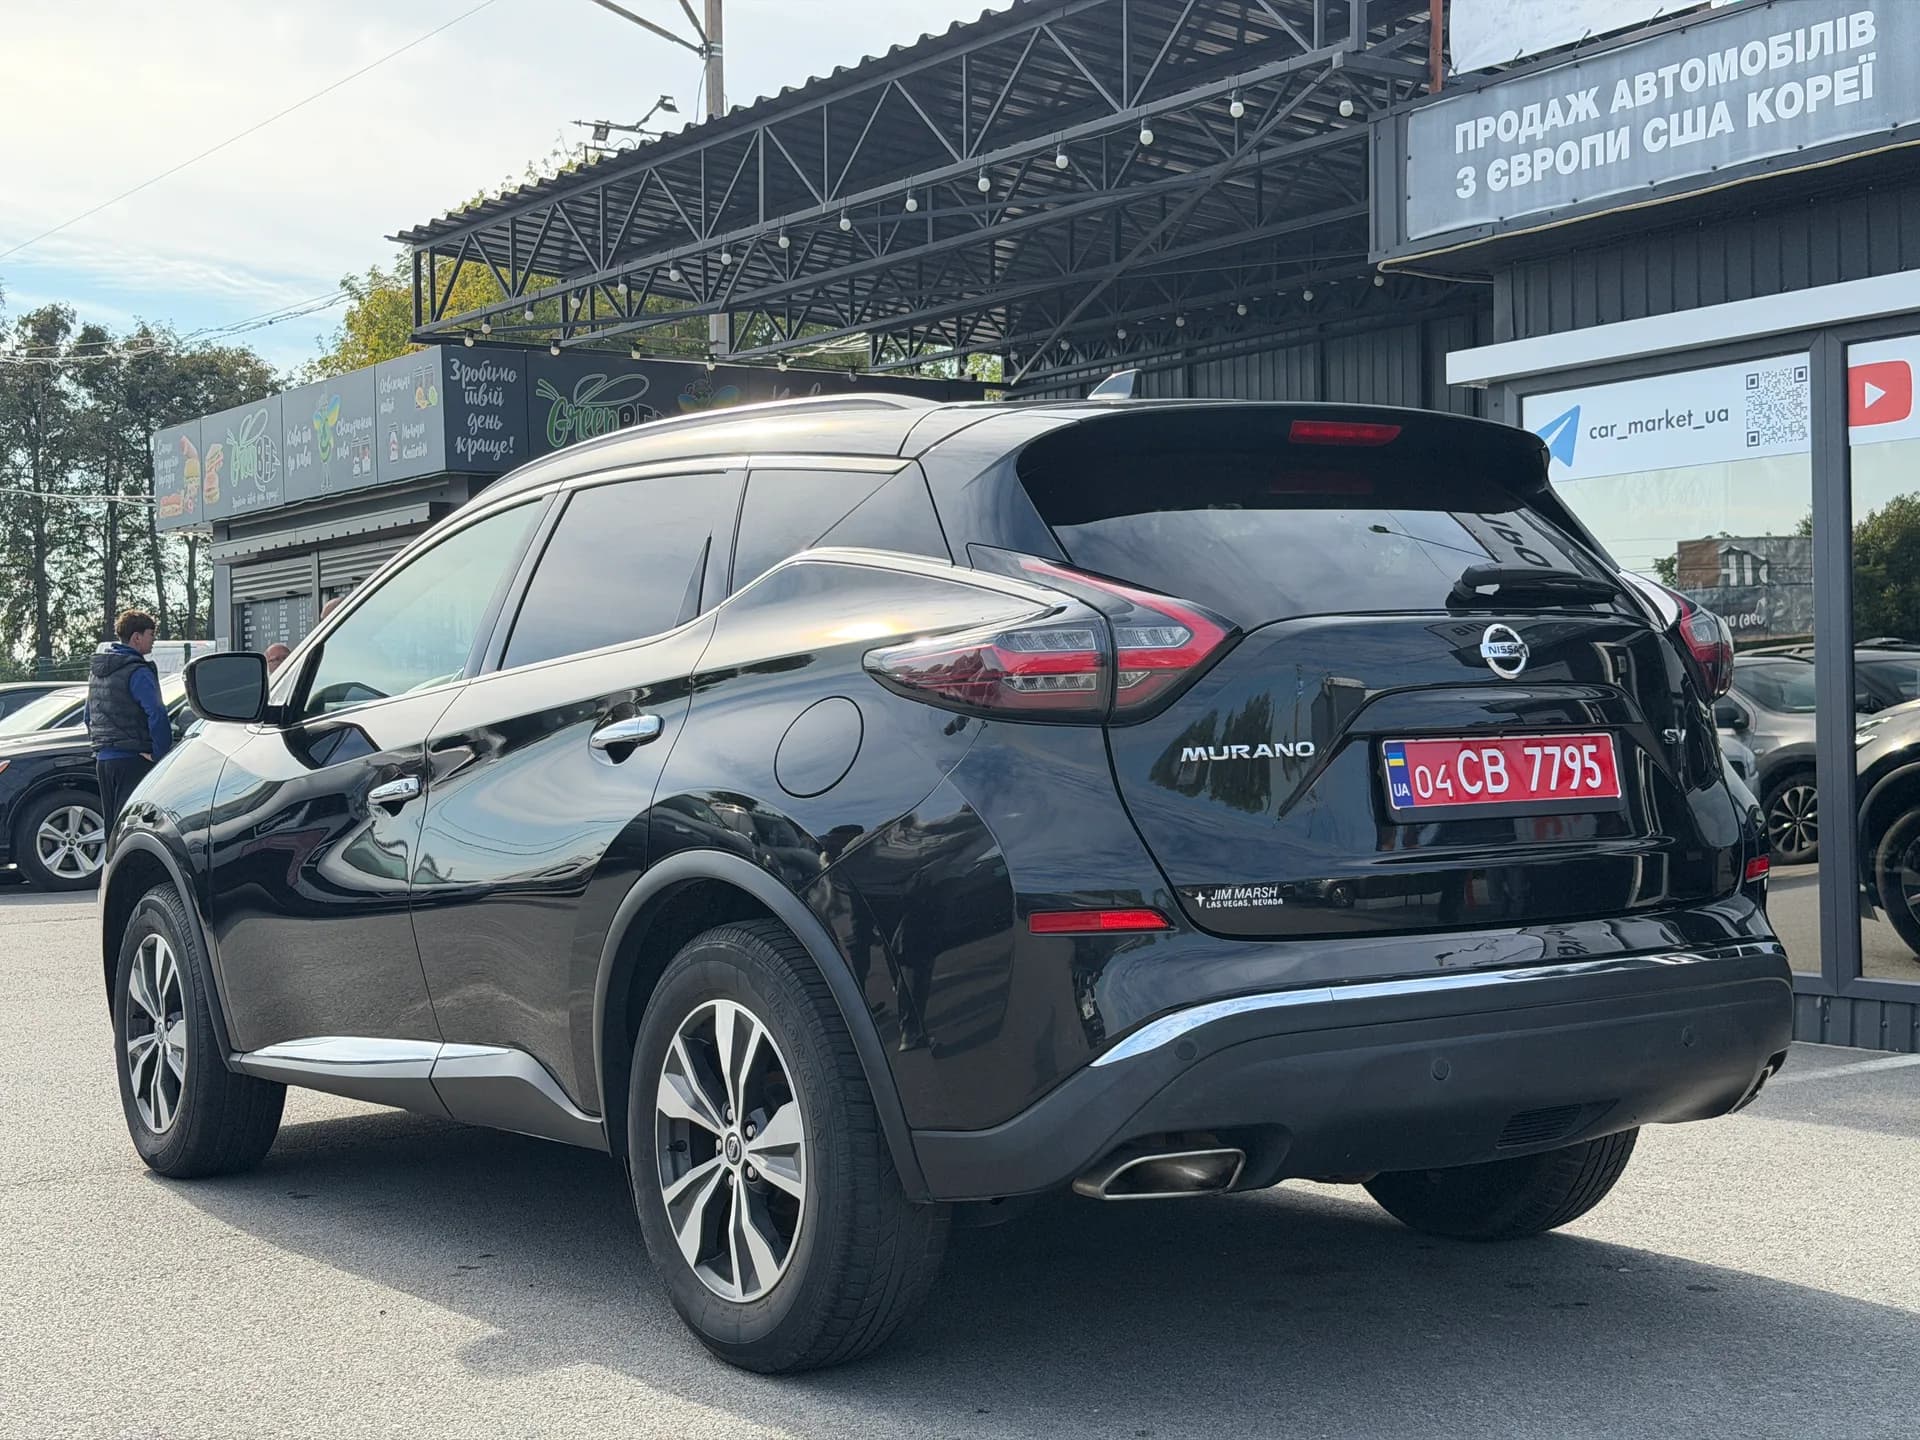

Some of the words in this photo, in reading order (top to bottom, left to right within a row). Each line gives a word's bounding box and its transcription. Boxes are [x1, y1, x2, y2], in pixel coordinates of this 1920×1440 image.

[1456, 87, 1600, 154] ПРОДАЖ
[1610, 10, 1876, 114] АВТОМОБІЛІВ
[1456, 167, 1476, 199] З
[1487, 126, 1631, 192] ЄВРОПИ
[1643, 101, 1735, 153] США
[1747, 53, 1877, 128] КОРЕЇ
[449, 358, 517, 389] Зробимо
[465, 383, 505, 407] твій
[467, 413, 503, 436] день
[1589, 406, 1728, 442] car_market_ua
[455, 436, 515, 462] краще!
[1180, 741, 1315, 763] MURANO
[1524, 744, 1602, 792] 7795
[1393, 783, 1410, 797] UA
[1206, 901, 1221, 909] LAS
[1252, 898, 1283, 906] NEVADA
[1211, 889, 1232, 901] JIM
[1234, 887, 1278, 899] MARSH
